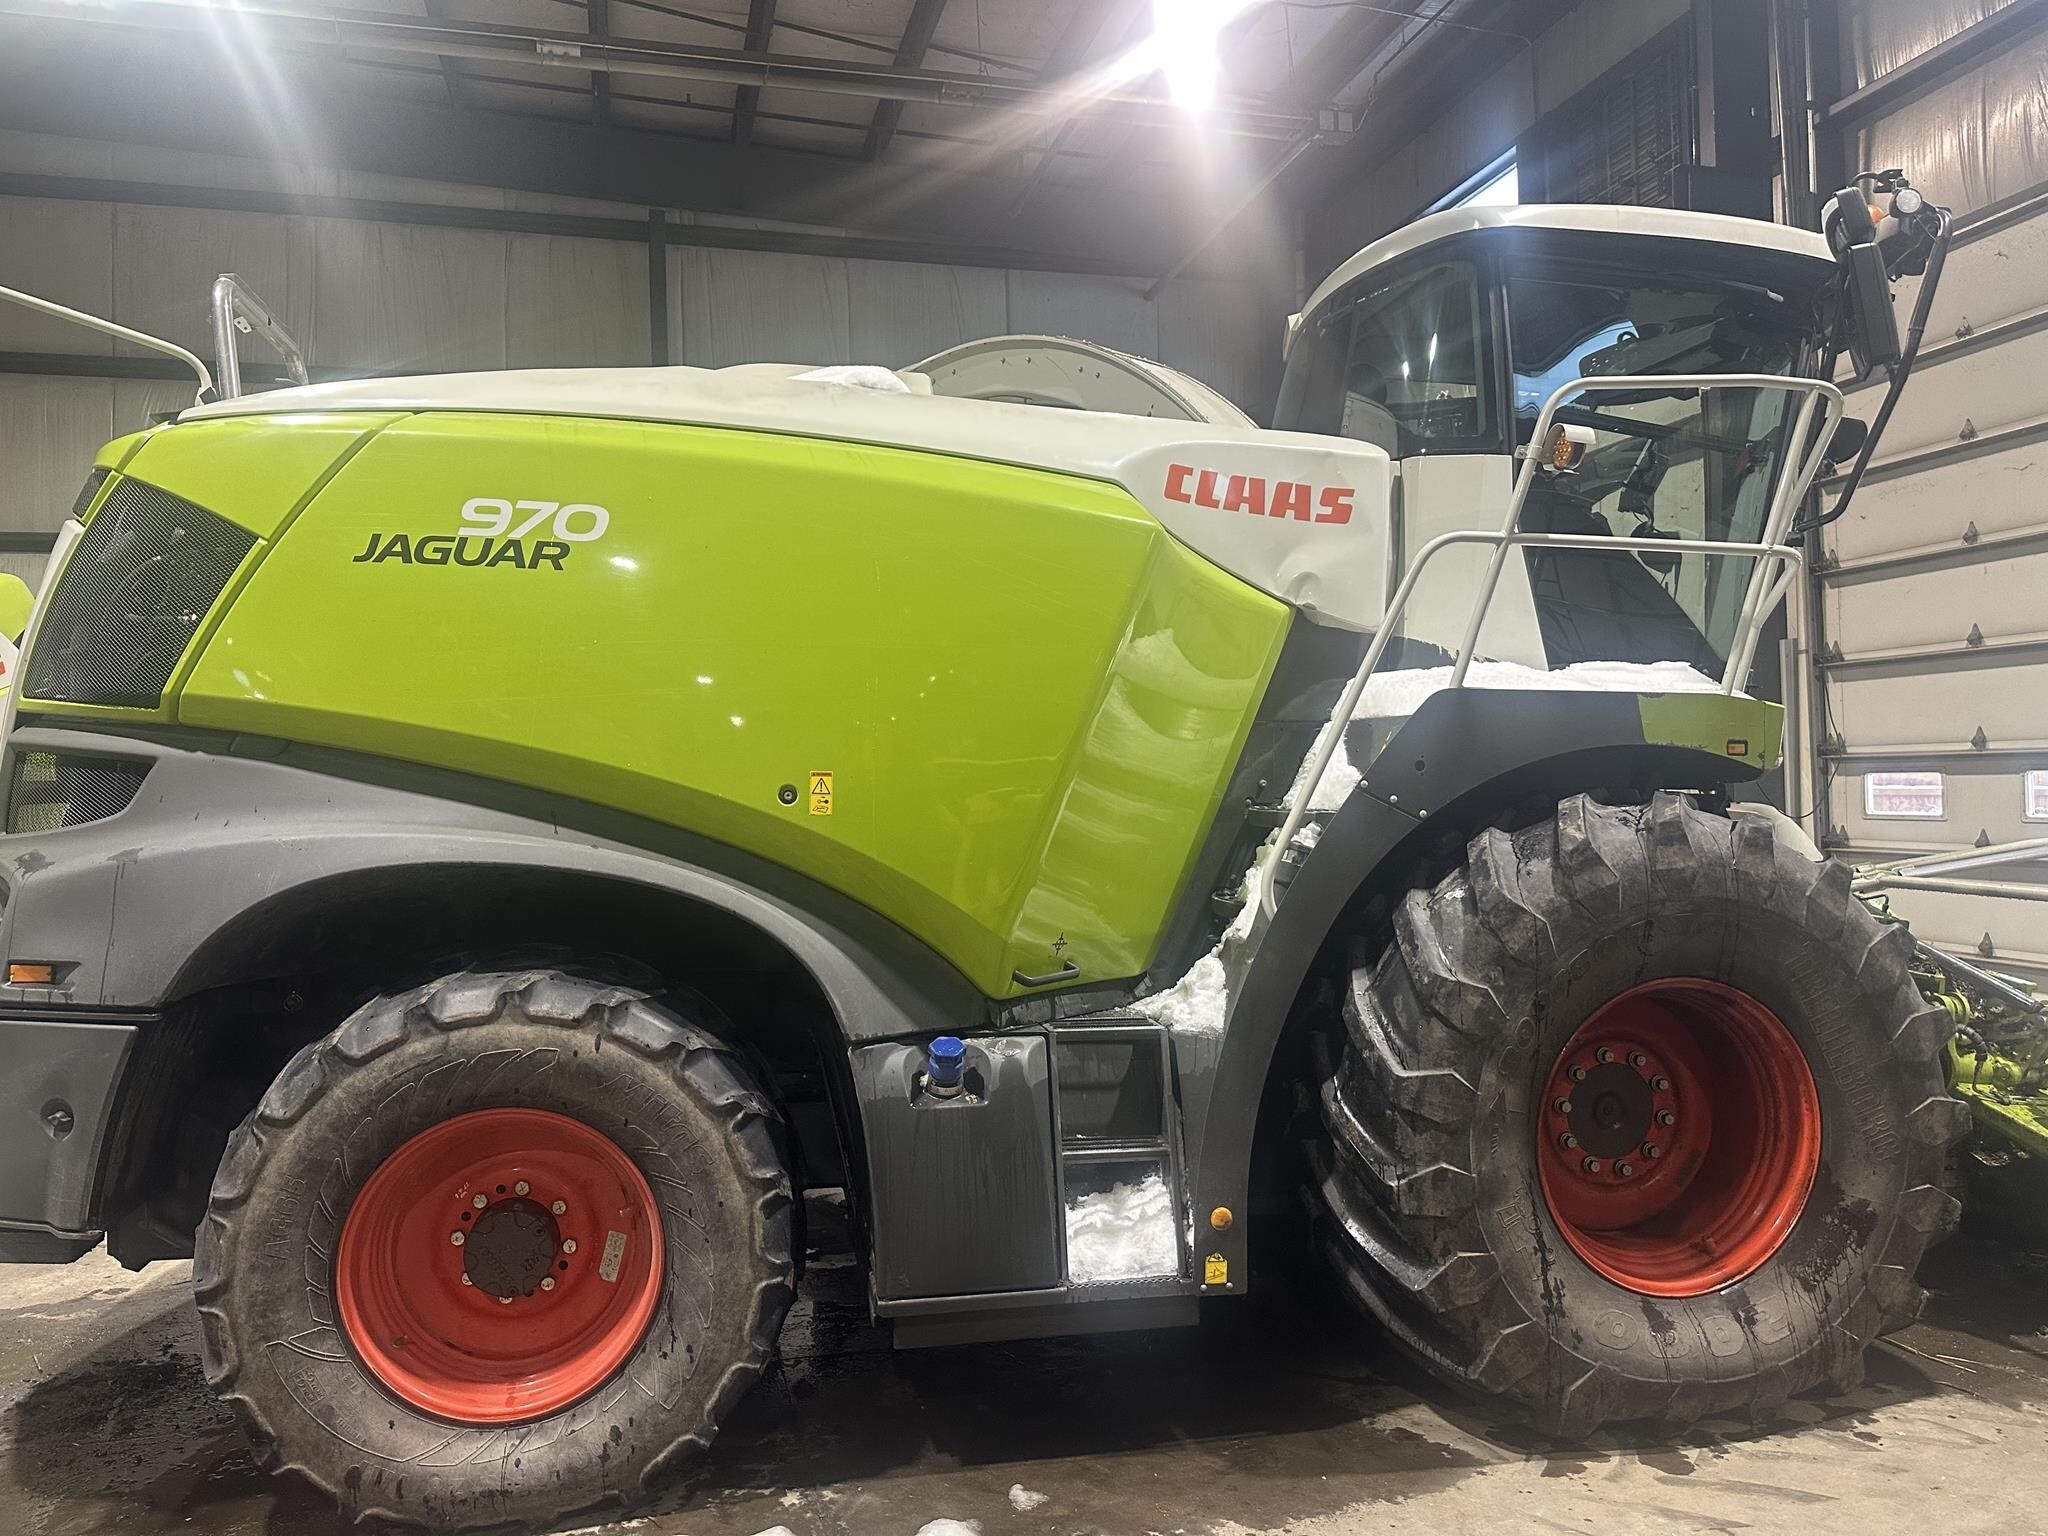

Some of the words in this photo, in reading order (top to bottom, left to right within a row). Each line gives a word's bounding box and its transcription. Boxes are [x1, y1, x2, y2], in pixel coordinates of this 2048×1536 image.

[1164, 464, 1355, 524] CLAAS
[457, 498, 609, 541] 970
[353, 534, 571, 571] JAGUAR
